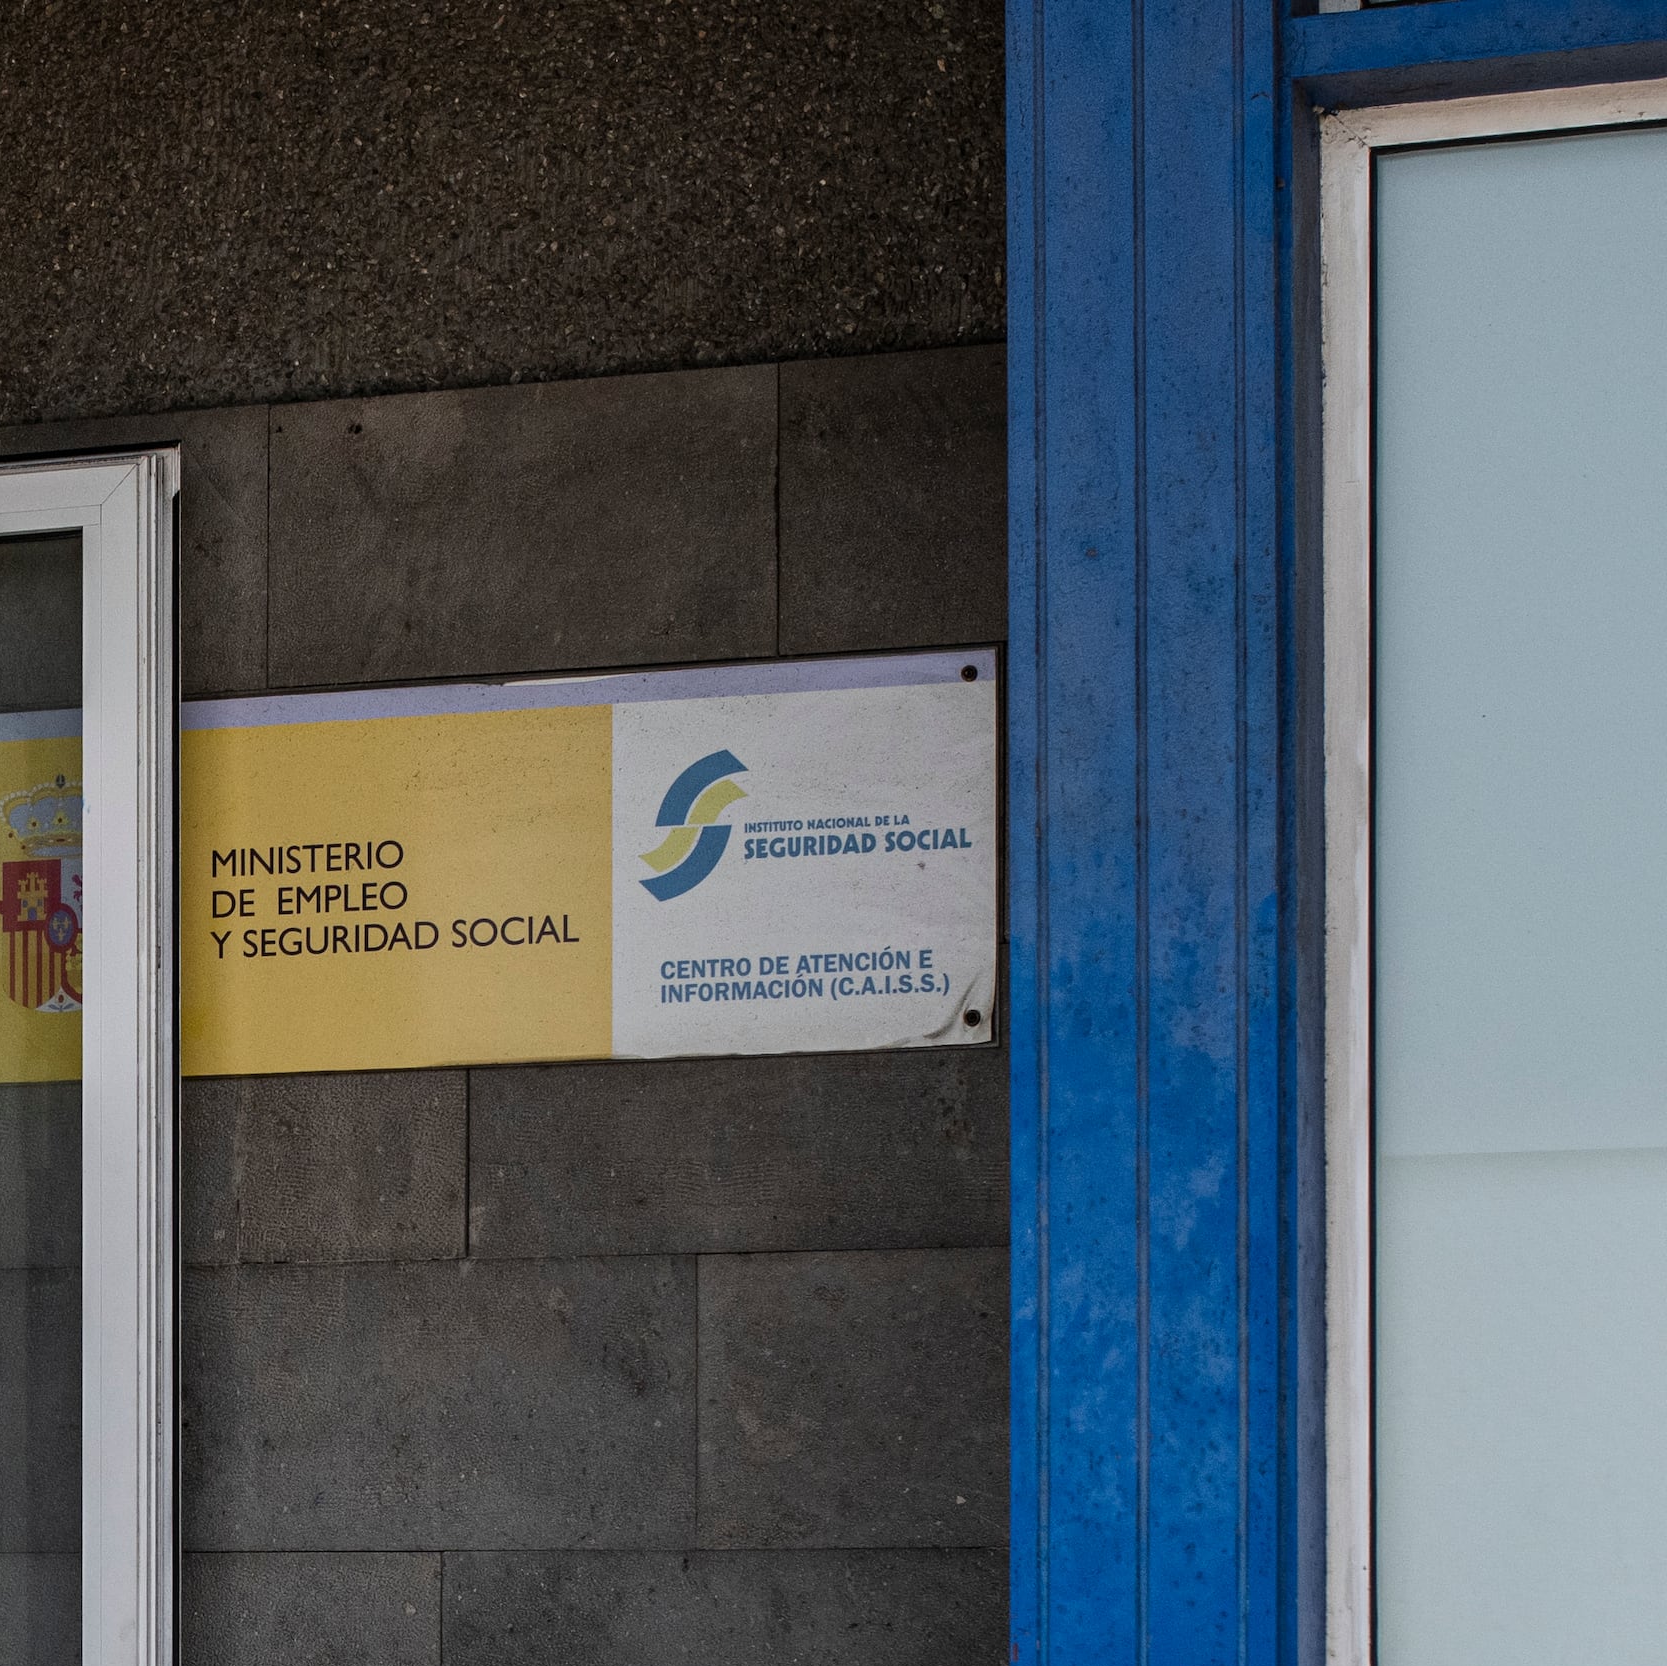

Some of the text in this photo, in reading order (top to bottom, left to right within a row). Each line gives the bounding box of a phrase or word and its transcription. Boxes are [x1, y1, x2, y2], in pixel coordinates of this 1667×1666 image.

[744, 814, 910, 834] INSTITUTO NACIONAL DE LA
[210, 840, 405, 880] MINISTERIO
[744, 827, 972, 860] SEGURIDAD SOCIAL
[212, 879, 409, 920] DE EMPLEO
[210, 913, 580, 961] Y SEGURIDAD SOCIAL
[661, 946, 933, 982] CENTRO DE ATENCIÓN E
[661, 973, 950, 1004] INFORMACIÓN (C.A.I.S.S.)
